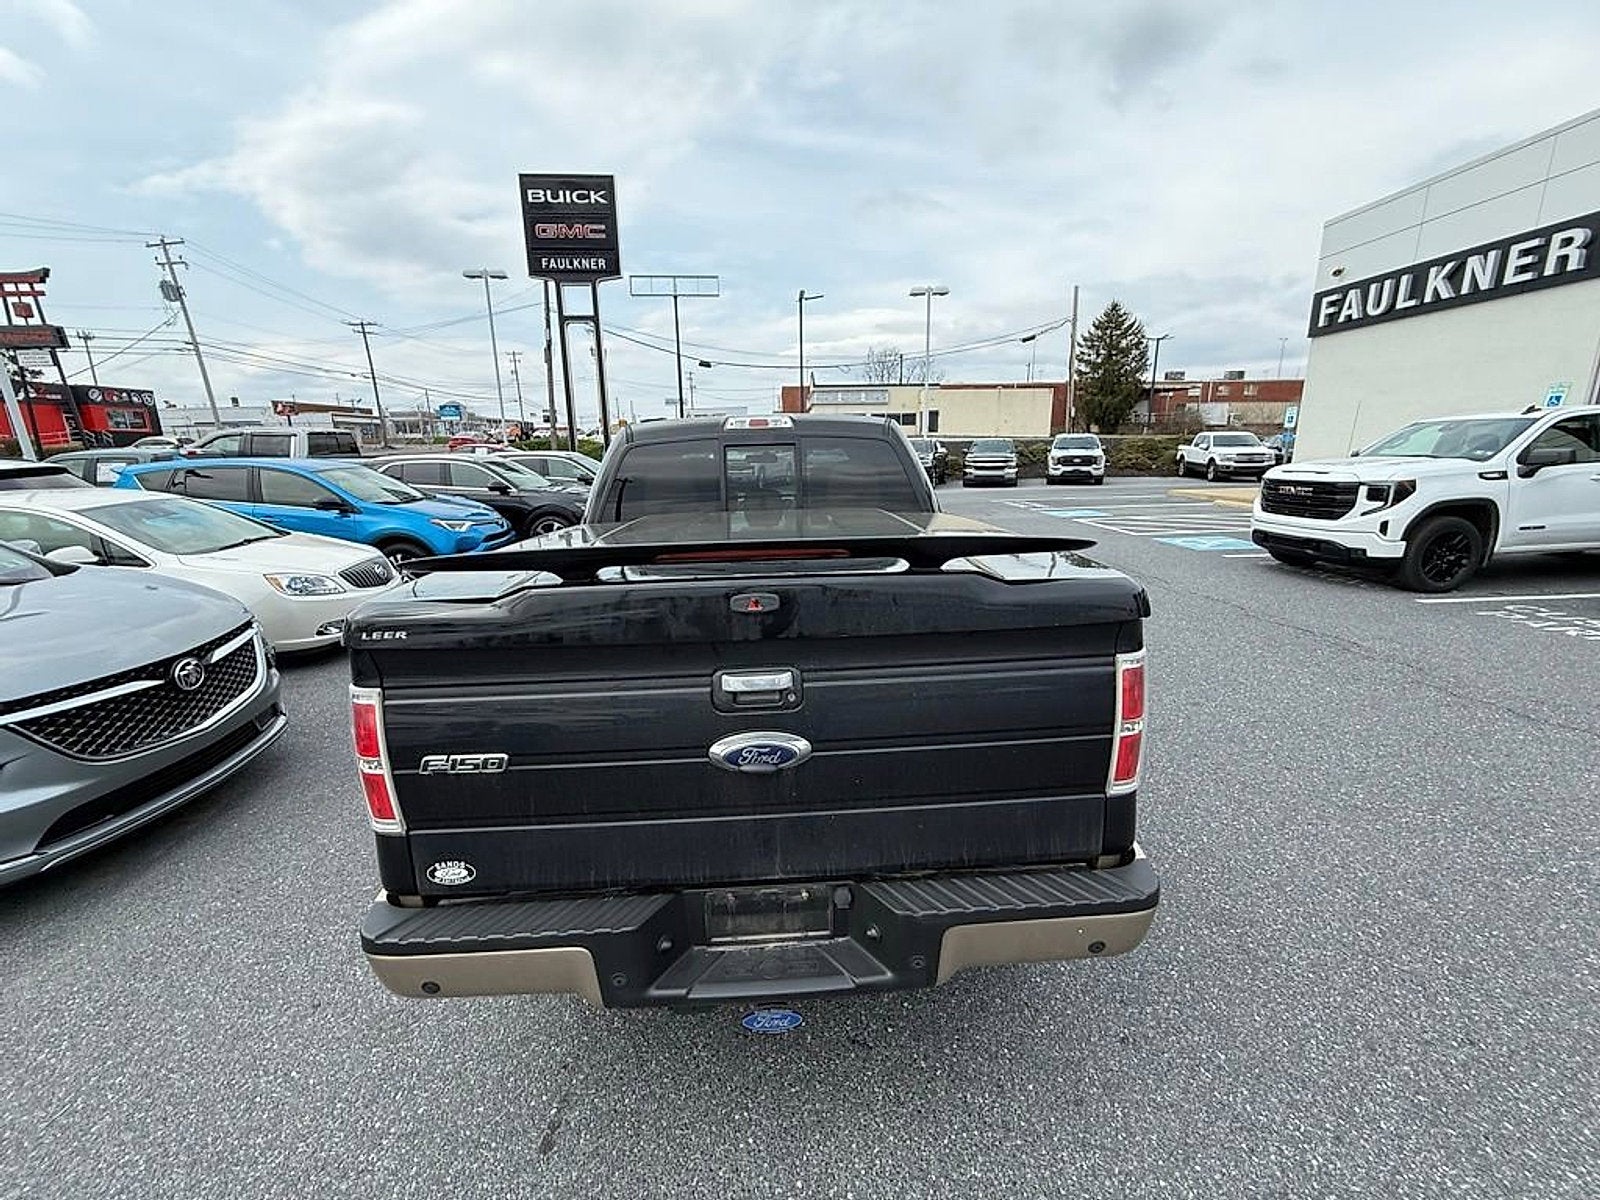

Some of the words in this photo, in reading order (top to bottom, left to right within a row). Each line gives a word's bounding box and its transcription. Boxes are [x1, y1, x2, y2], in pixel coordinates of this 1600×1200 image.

[526, 189, 609, 204] BUICK
[534, 223, 606, 239] GMC
[541, 257, 606, 269] FAULKNER
[1318, 227, 1593, 329] FAULKNER
[361, 631, 408, 640] LEER
